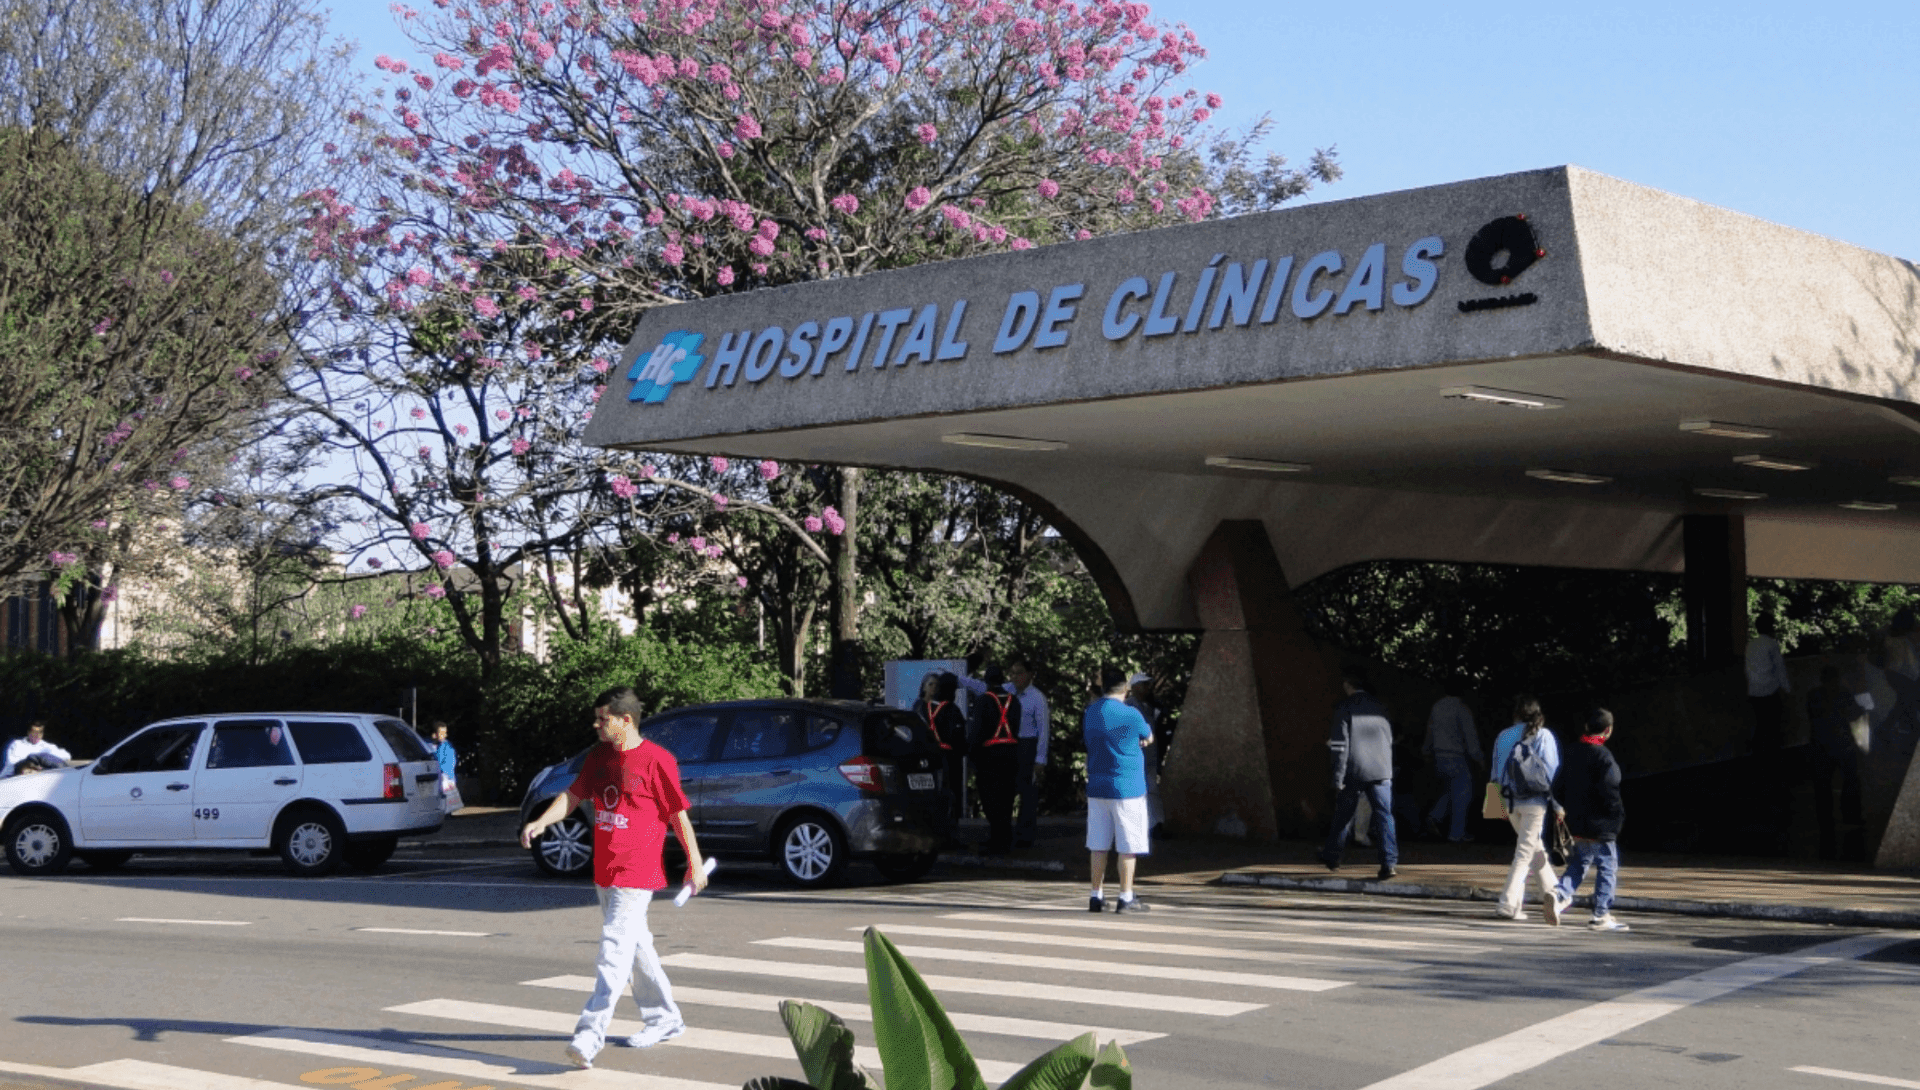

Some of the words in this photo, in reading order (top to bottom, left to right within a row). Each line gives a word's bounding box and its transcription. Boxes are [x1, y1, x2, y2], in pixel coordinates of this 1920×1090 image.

[705, 299, 968, 388] HOSPITAL
[993, 282, 1085, 354] DE
[1102, 235, 1445, 341] CLÍNICAS
[638, 343, 687, 386] HC
[194, 807, 220, 820] 499
